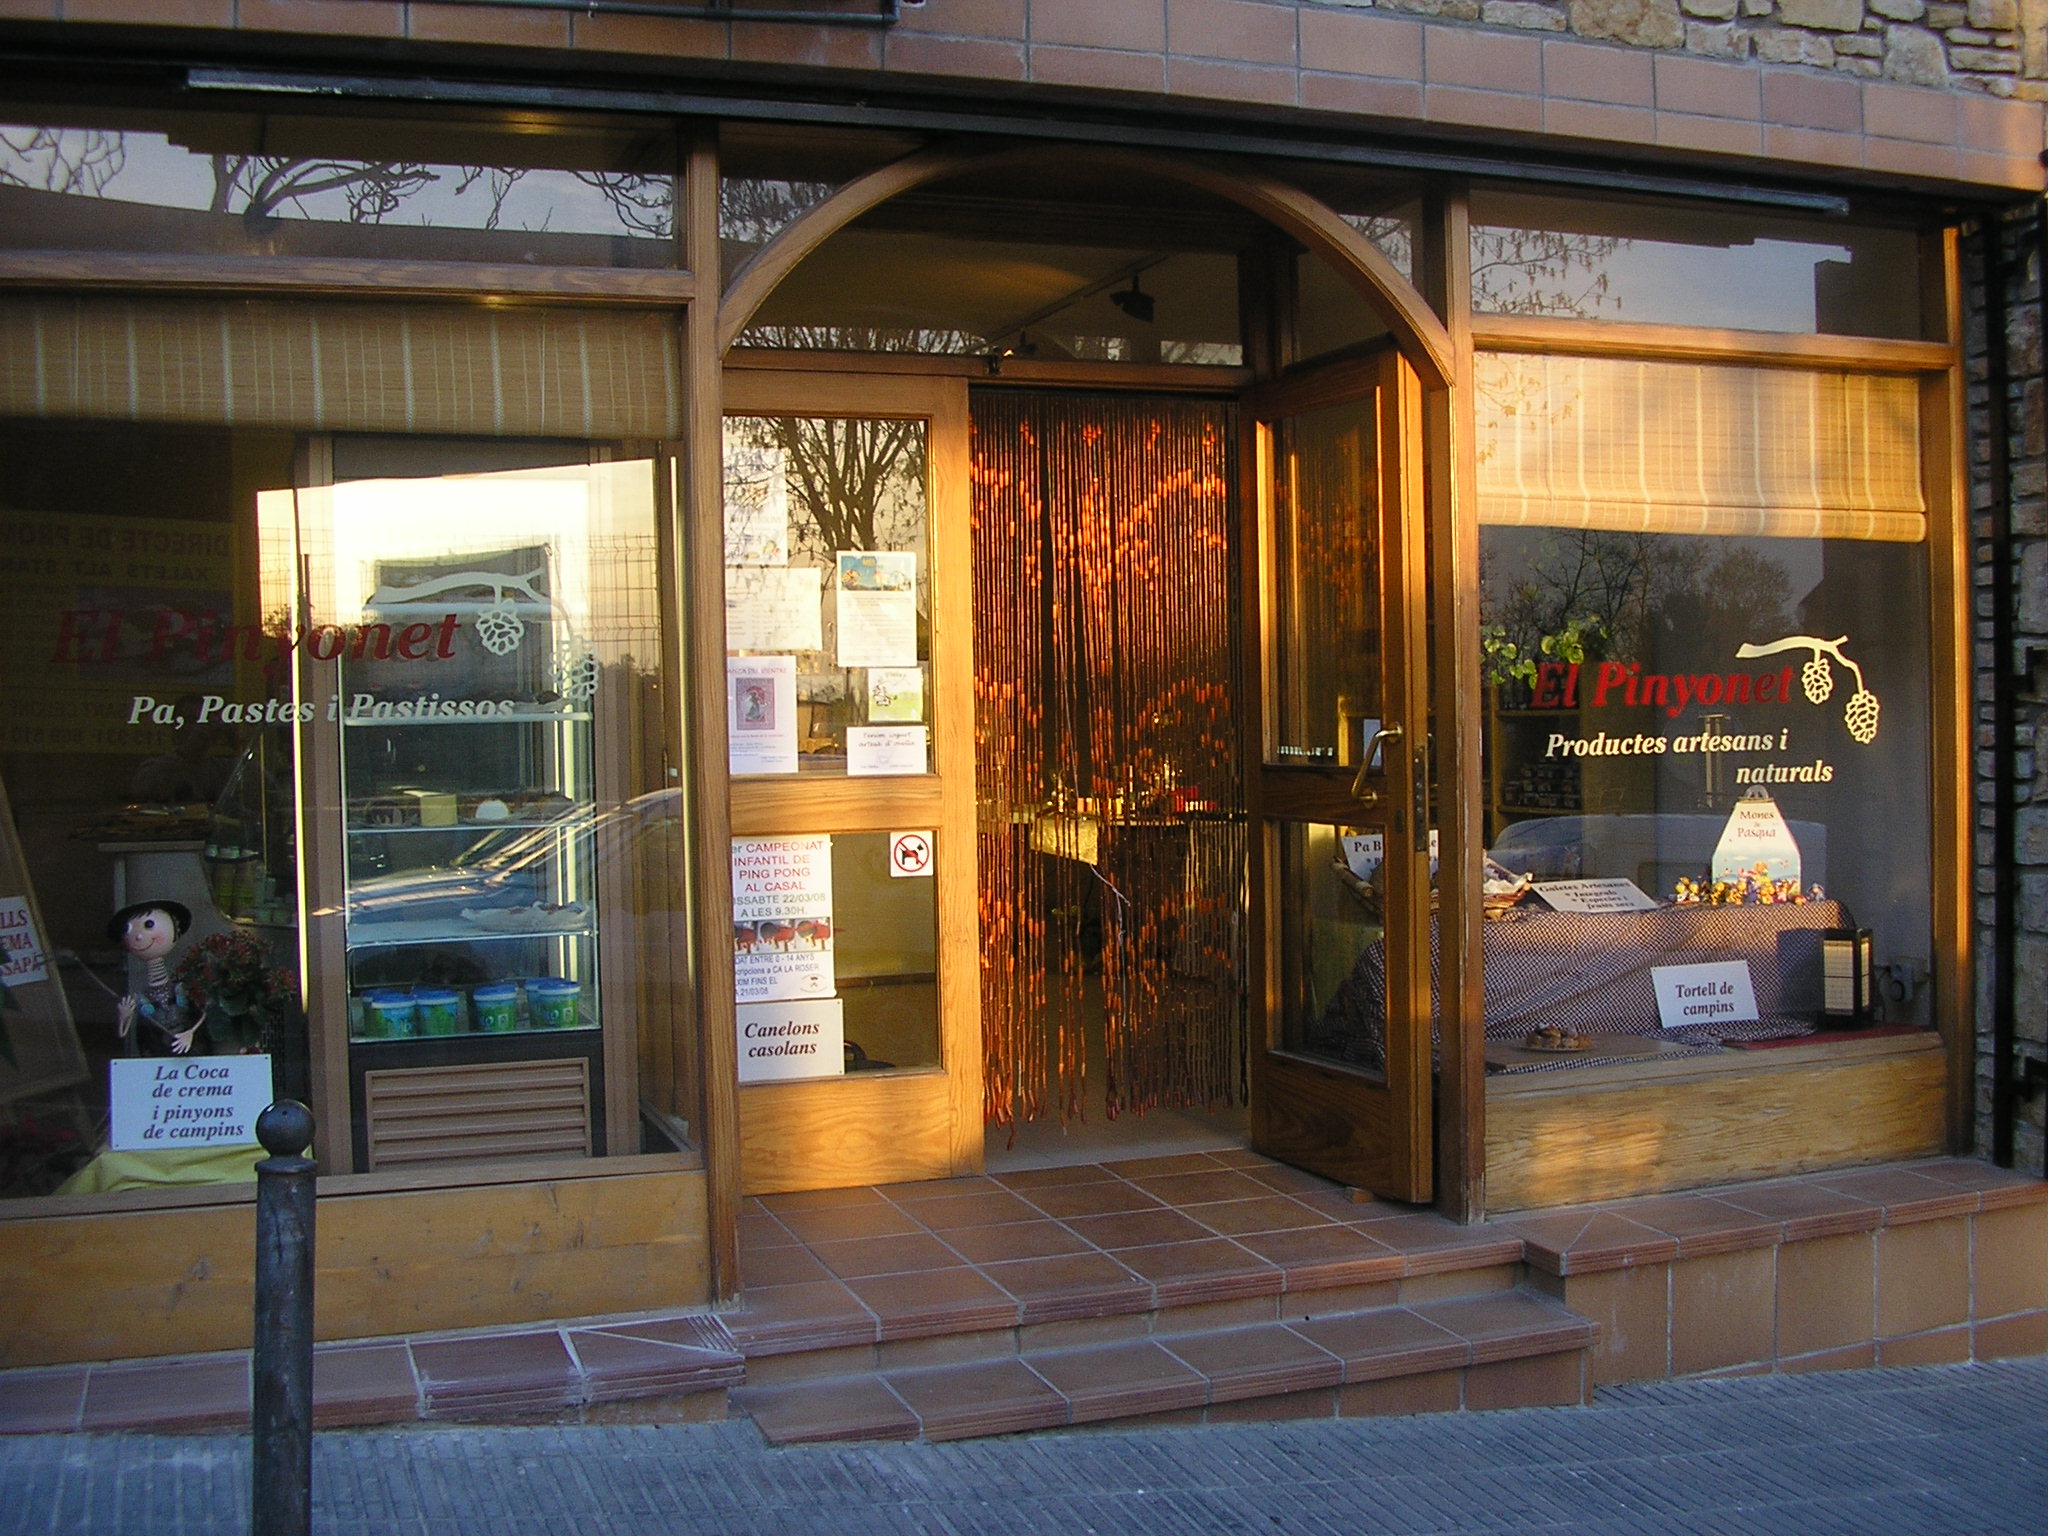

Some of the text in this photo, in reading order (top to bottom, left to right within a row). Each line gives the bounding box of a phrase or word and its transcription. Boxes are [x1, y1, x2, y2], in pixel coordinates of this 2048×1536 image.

[50, 608, 124, 664] El
[145, 608, 462, 679] Pinyonet
[1531, 661, 1794, 717] El Pinyonet
[127, 692, 516, 729] Pa, Pastes i Pastissos
[1545, 729, 1789, 758] Productes artesans i
[1736, 760, 1834, 785] naturals
[1740, 810, 1775, 820] Mones
[1738, 827, 1776, 840] Pasqua
[746, 841, 824, 854] CAMPEONAT
[734, 854, 811, 867] INFANTIL DE
[739, 867, 811, 880] PING PONG
[745, 880, 805, 893] AL CASAL
[741, 908, 749, 918] A
[752, 907, 772, 918] LES
[750, 954, 773, 965] ENTRE
[1675, 981, 1734, 998] Tortell de
[1683, 998, 1735, 1018] campins
[745, 1021, 820, 1039] Canelons
[748, 1040, 817, 1058] casolans
[155, 1063, 230, 1081] La Coca
[152, 1082, 233, 1099] de crema
[152, 1102, 234, 1124] i pinyons
[143, 1120, 244, 1143] de campins
